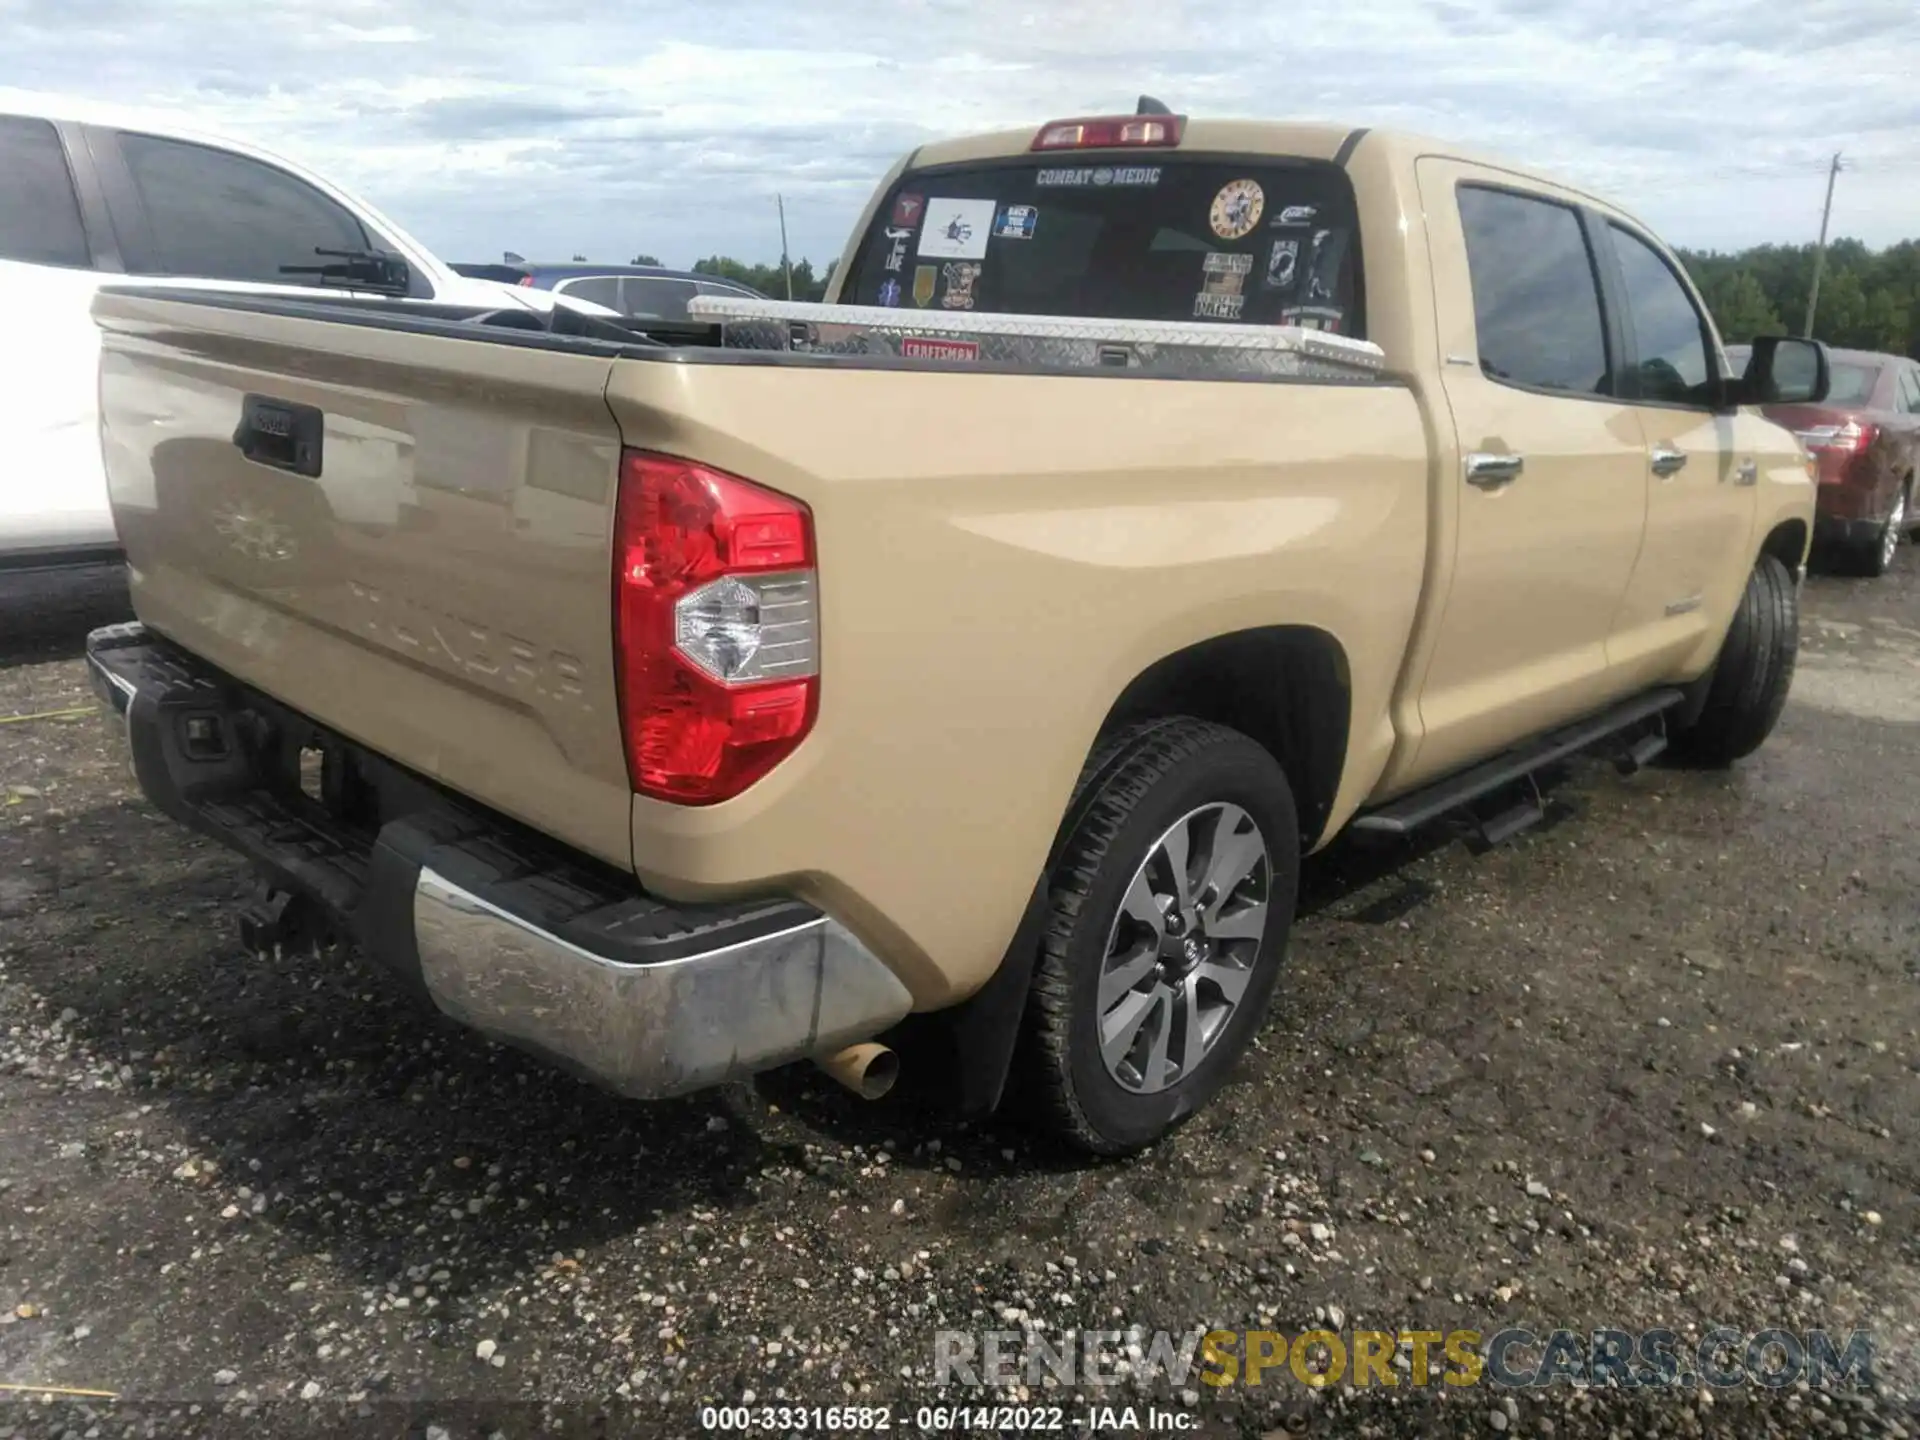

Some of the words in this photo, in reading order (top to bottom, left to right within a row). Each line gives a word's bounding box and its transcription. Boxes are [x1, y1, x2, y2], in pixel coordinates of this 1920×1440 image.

[1036, 168, 1093, 185] COMBAT
[1112, 167, 1161, 185] MEDIC
[906, 343, 975, 361] CRAFTSMAN
